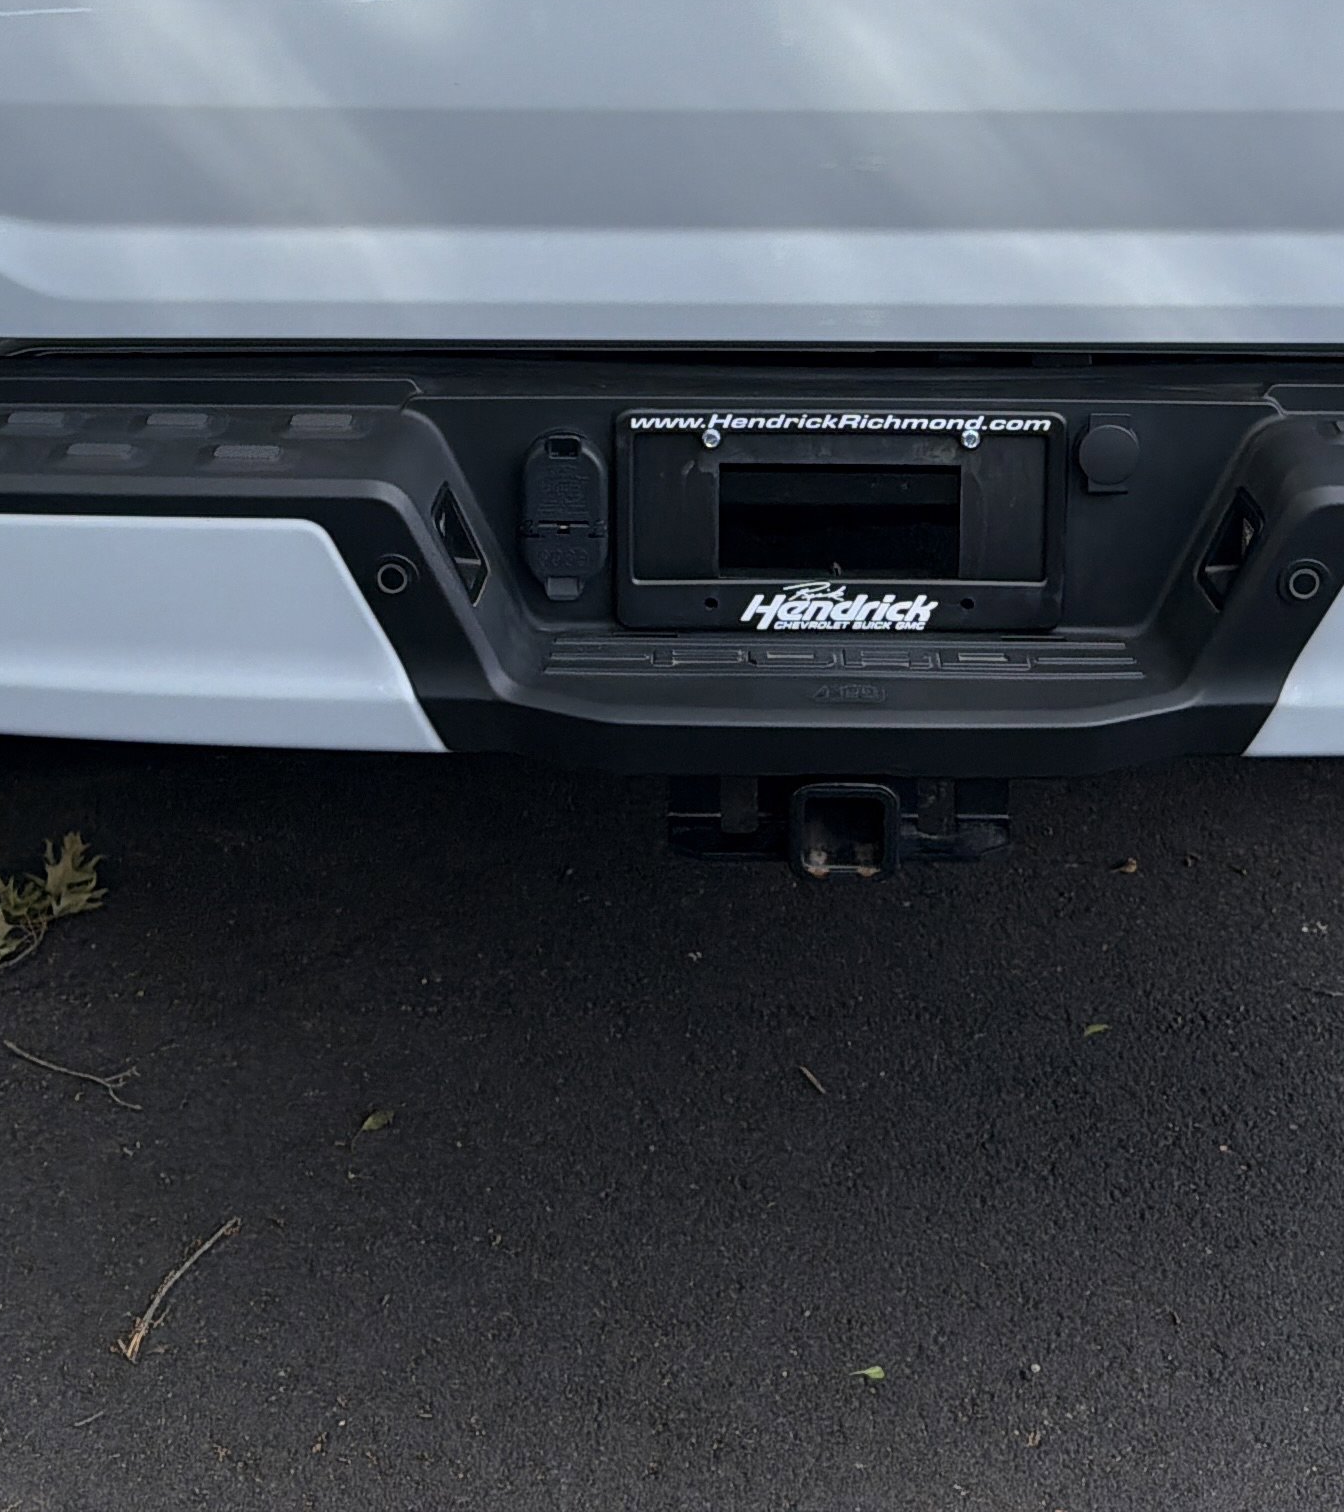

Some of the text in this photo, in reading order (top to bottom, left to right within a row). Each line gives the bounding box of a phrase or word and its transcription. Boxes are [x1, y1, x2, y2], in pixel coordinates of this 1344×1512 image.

[629, 413, 1052, 432] www.HendrickRichmond.com
[740, 594, 939, 631] Hendrick
[773, 620, 926, 631] CHEVROLET BUICK GMC
